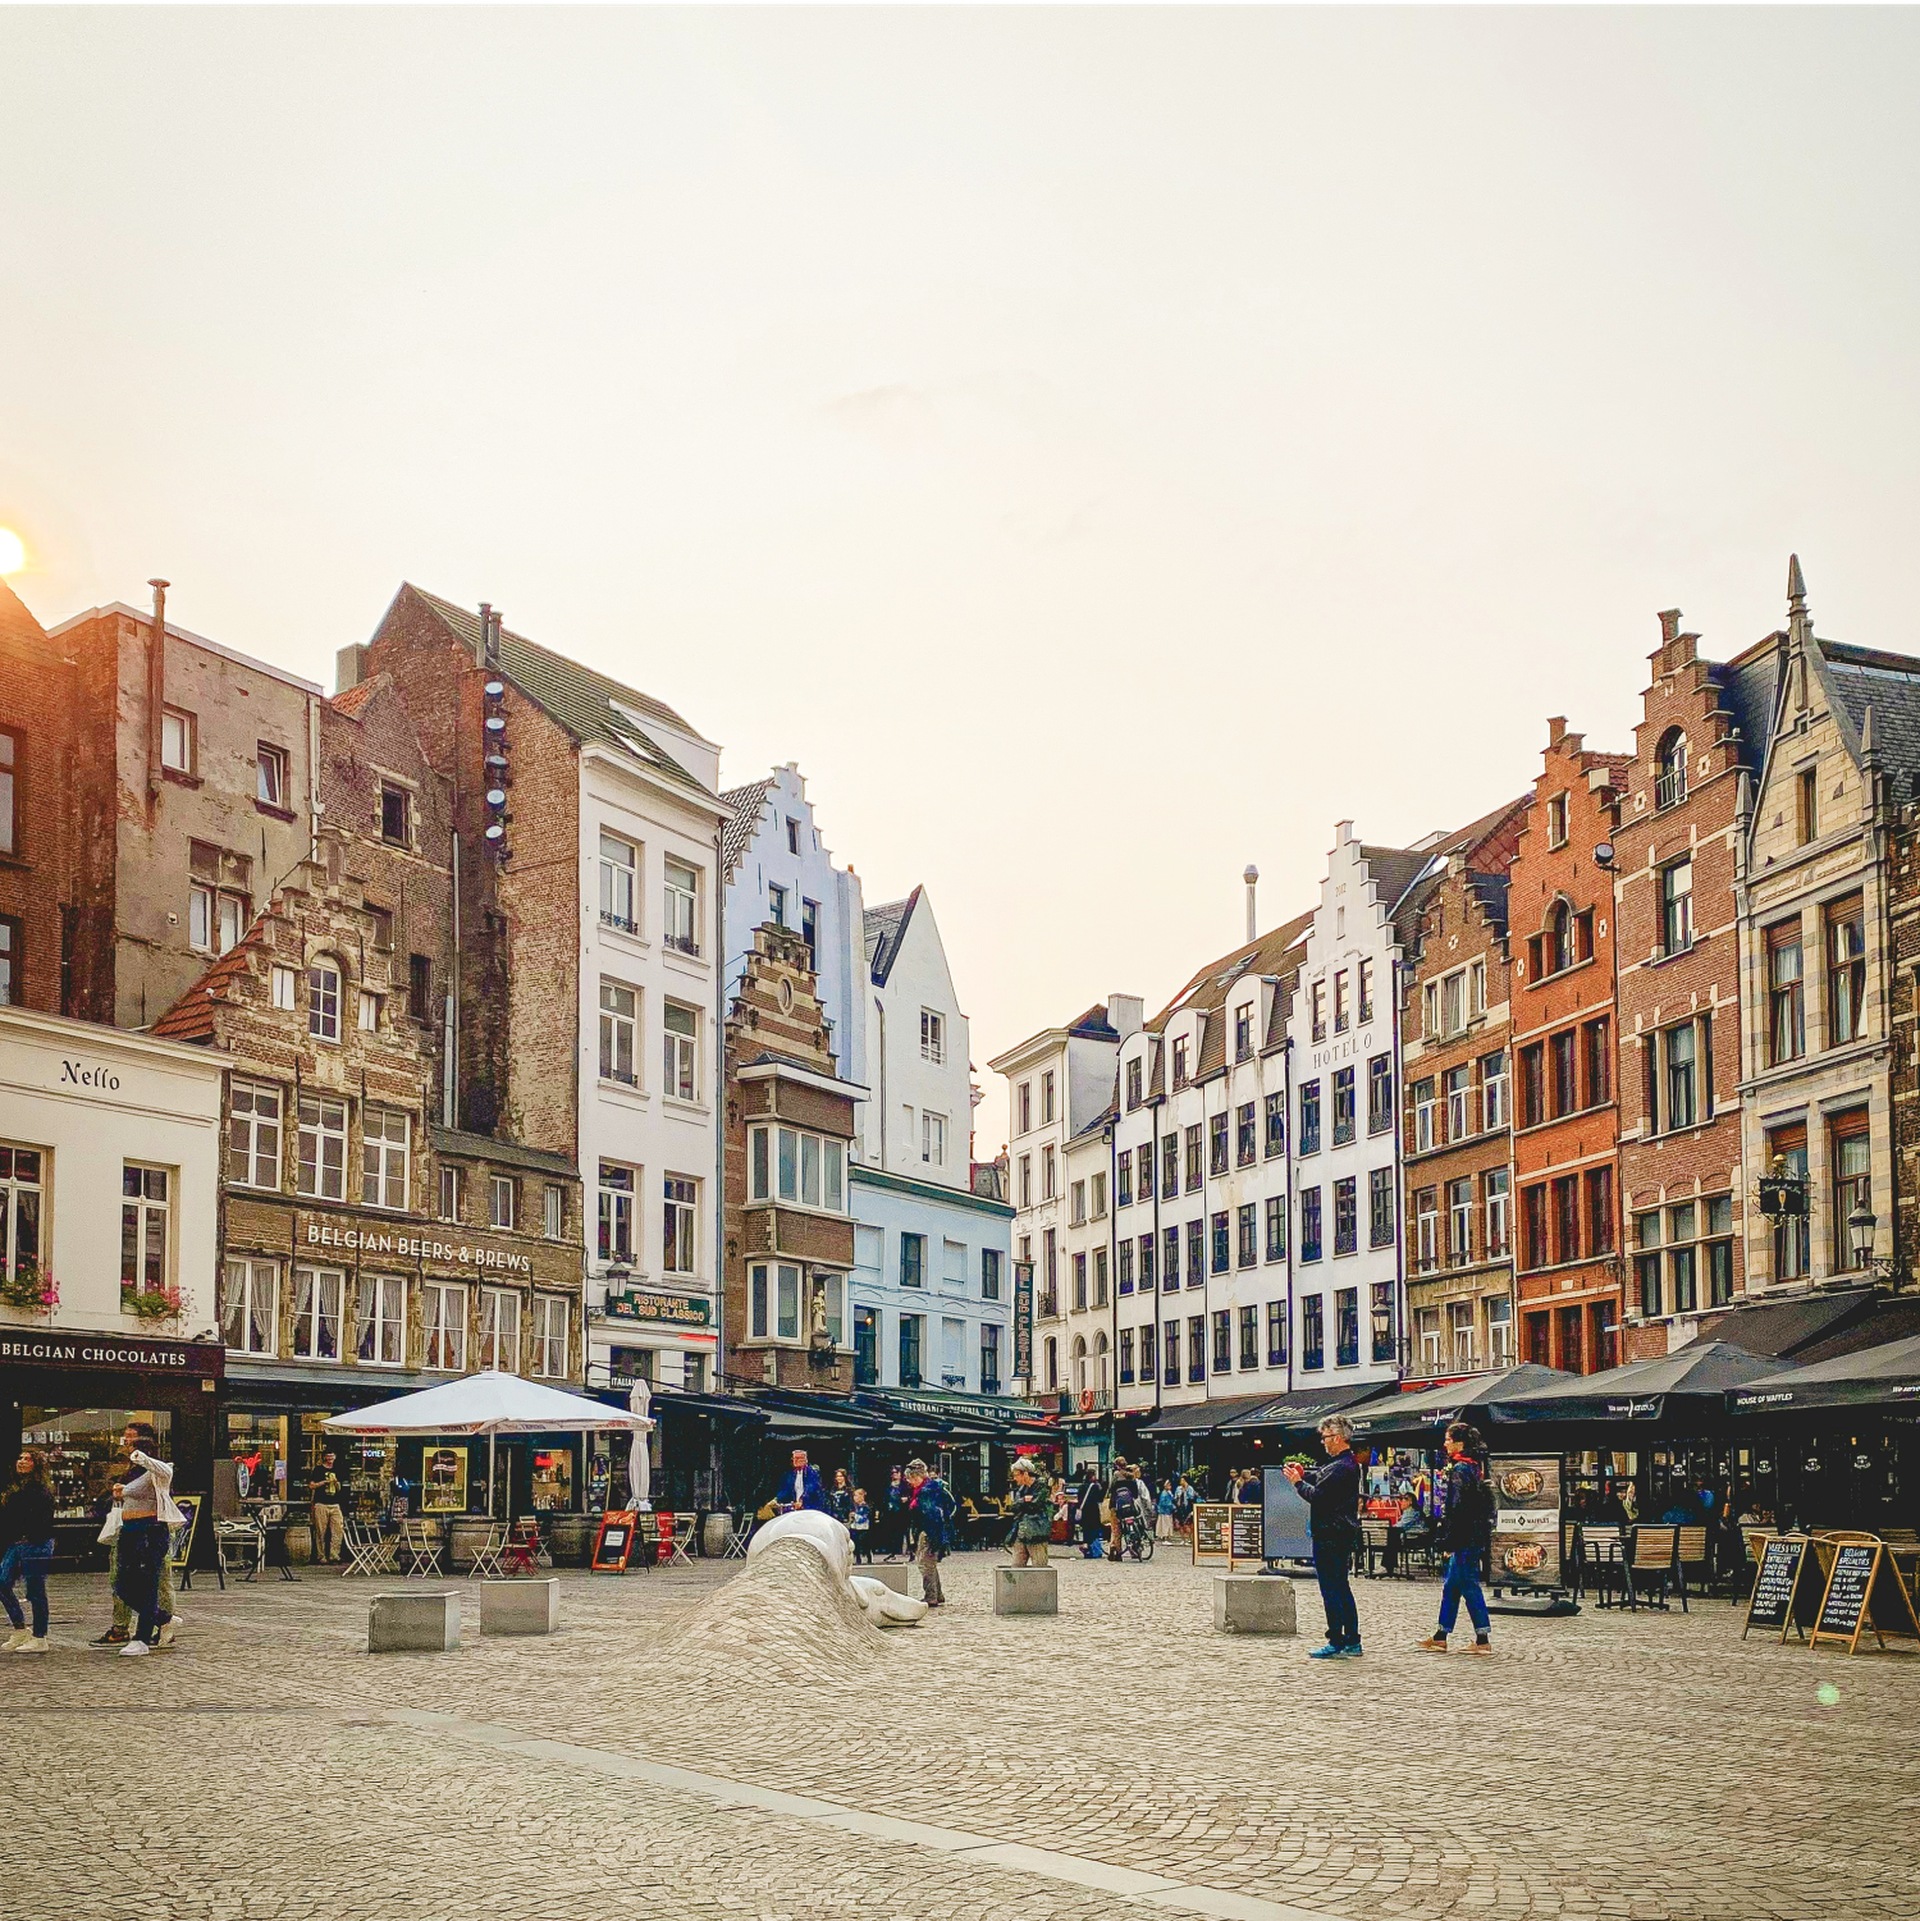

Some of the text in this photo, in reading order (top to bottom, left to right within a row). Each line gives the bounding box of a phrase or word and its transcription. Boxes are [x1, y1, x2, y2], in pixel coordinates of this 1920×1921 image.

[1313, 1033, 1372, 1069] HOTEL O
[61, 1060, 120, 1090] Nello
[308, 1225, 529, 1272] BELGIAN BEERS & BREWS
[633, 1293, 689, 1309] RISTORANTE
[638, 1305, 657, 1317] SUD
[660, 1308, 705, 1322] CLASSICO
[2, 1343, 186, 1365] BELGIAN CHOCOLATES
[1737, 1396, 1757, 1405] HOUSE
